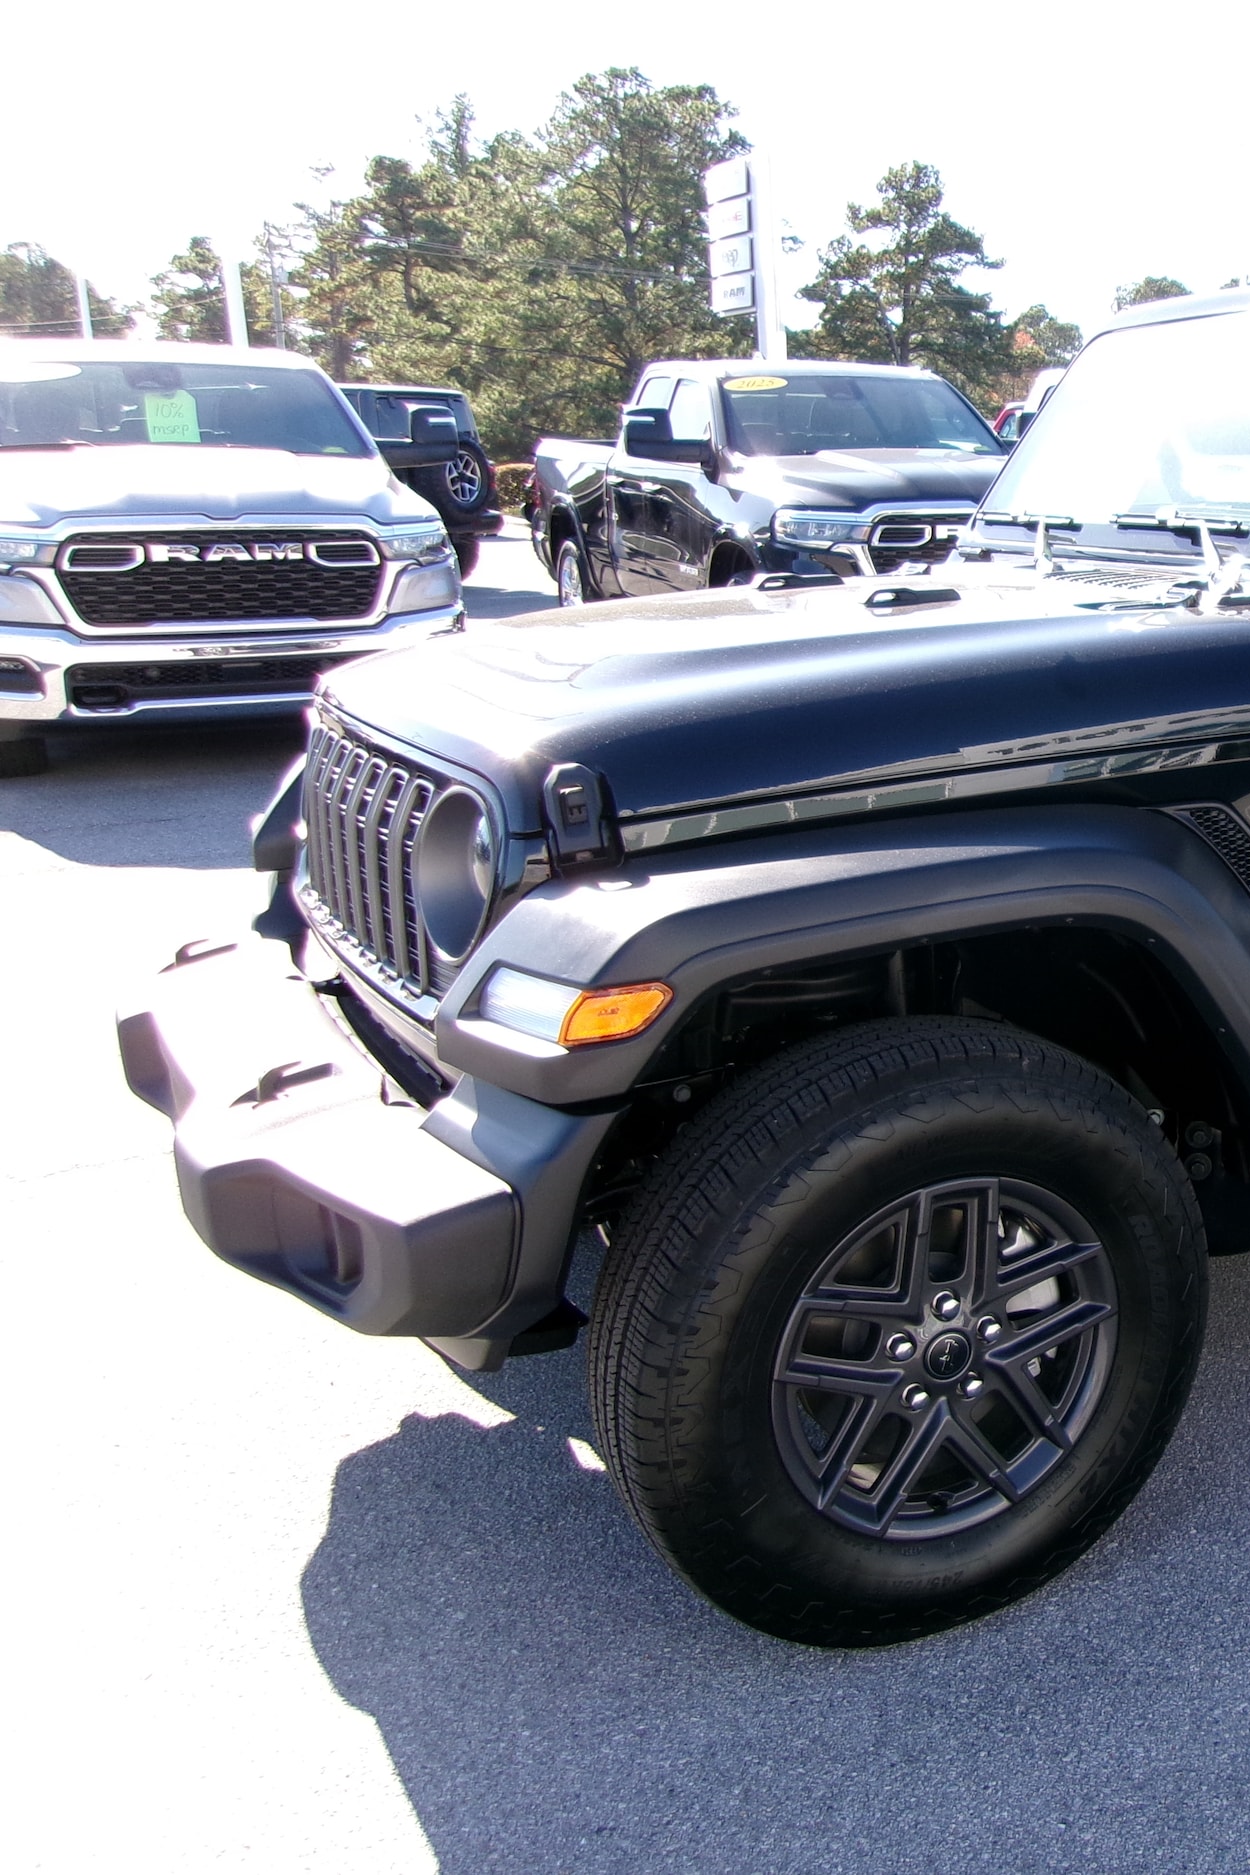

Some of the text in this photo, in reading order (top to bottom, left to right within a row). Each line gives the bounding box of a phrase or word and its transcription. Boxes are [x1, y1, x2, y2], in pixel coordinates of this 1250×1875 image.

[722, 286, 746, 299] RAM
[736, 379, 776, 389] 2025
[154, 401, 185, 419] 10%
[149, 542, 304, 562] RAM
